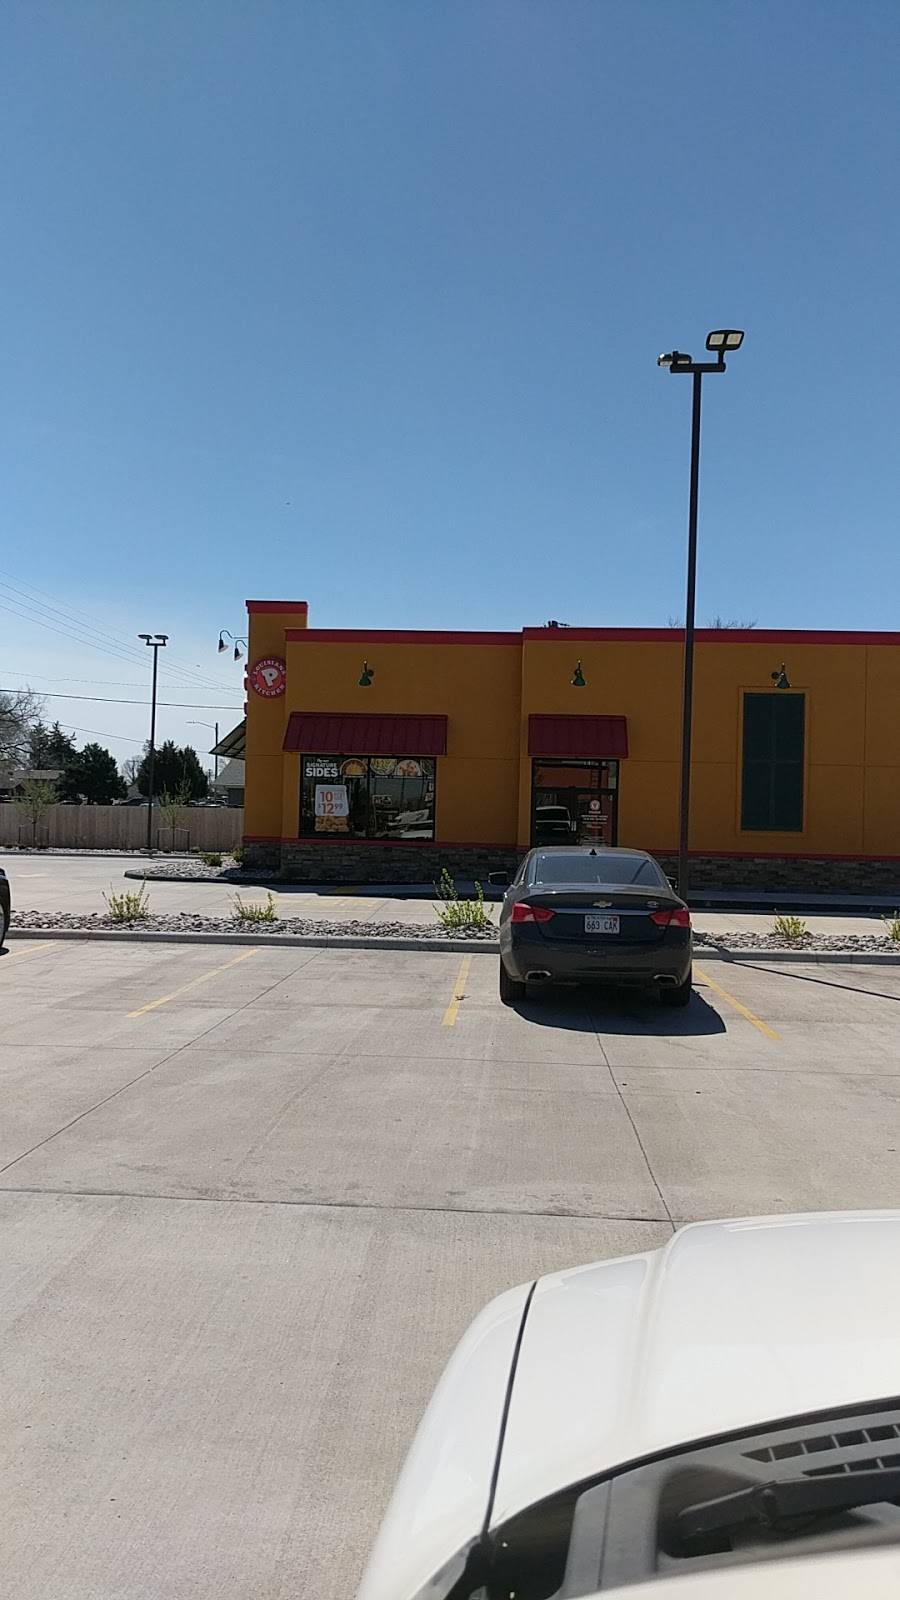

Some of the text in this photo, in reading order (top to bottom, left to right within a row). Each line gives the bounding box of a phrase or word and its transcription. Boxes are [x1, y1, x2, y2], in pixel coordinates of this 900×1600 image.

[261, 668, 279, 687] P
[305, 767, 338, 778] SIDES
[319, 791, 334, 802] 10
